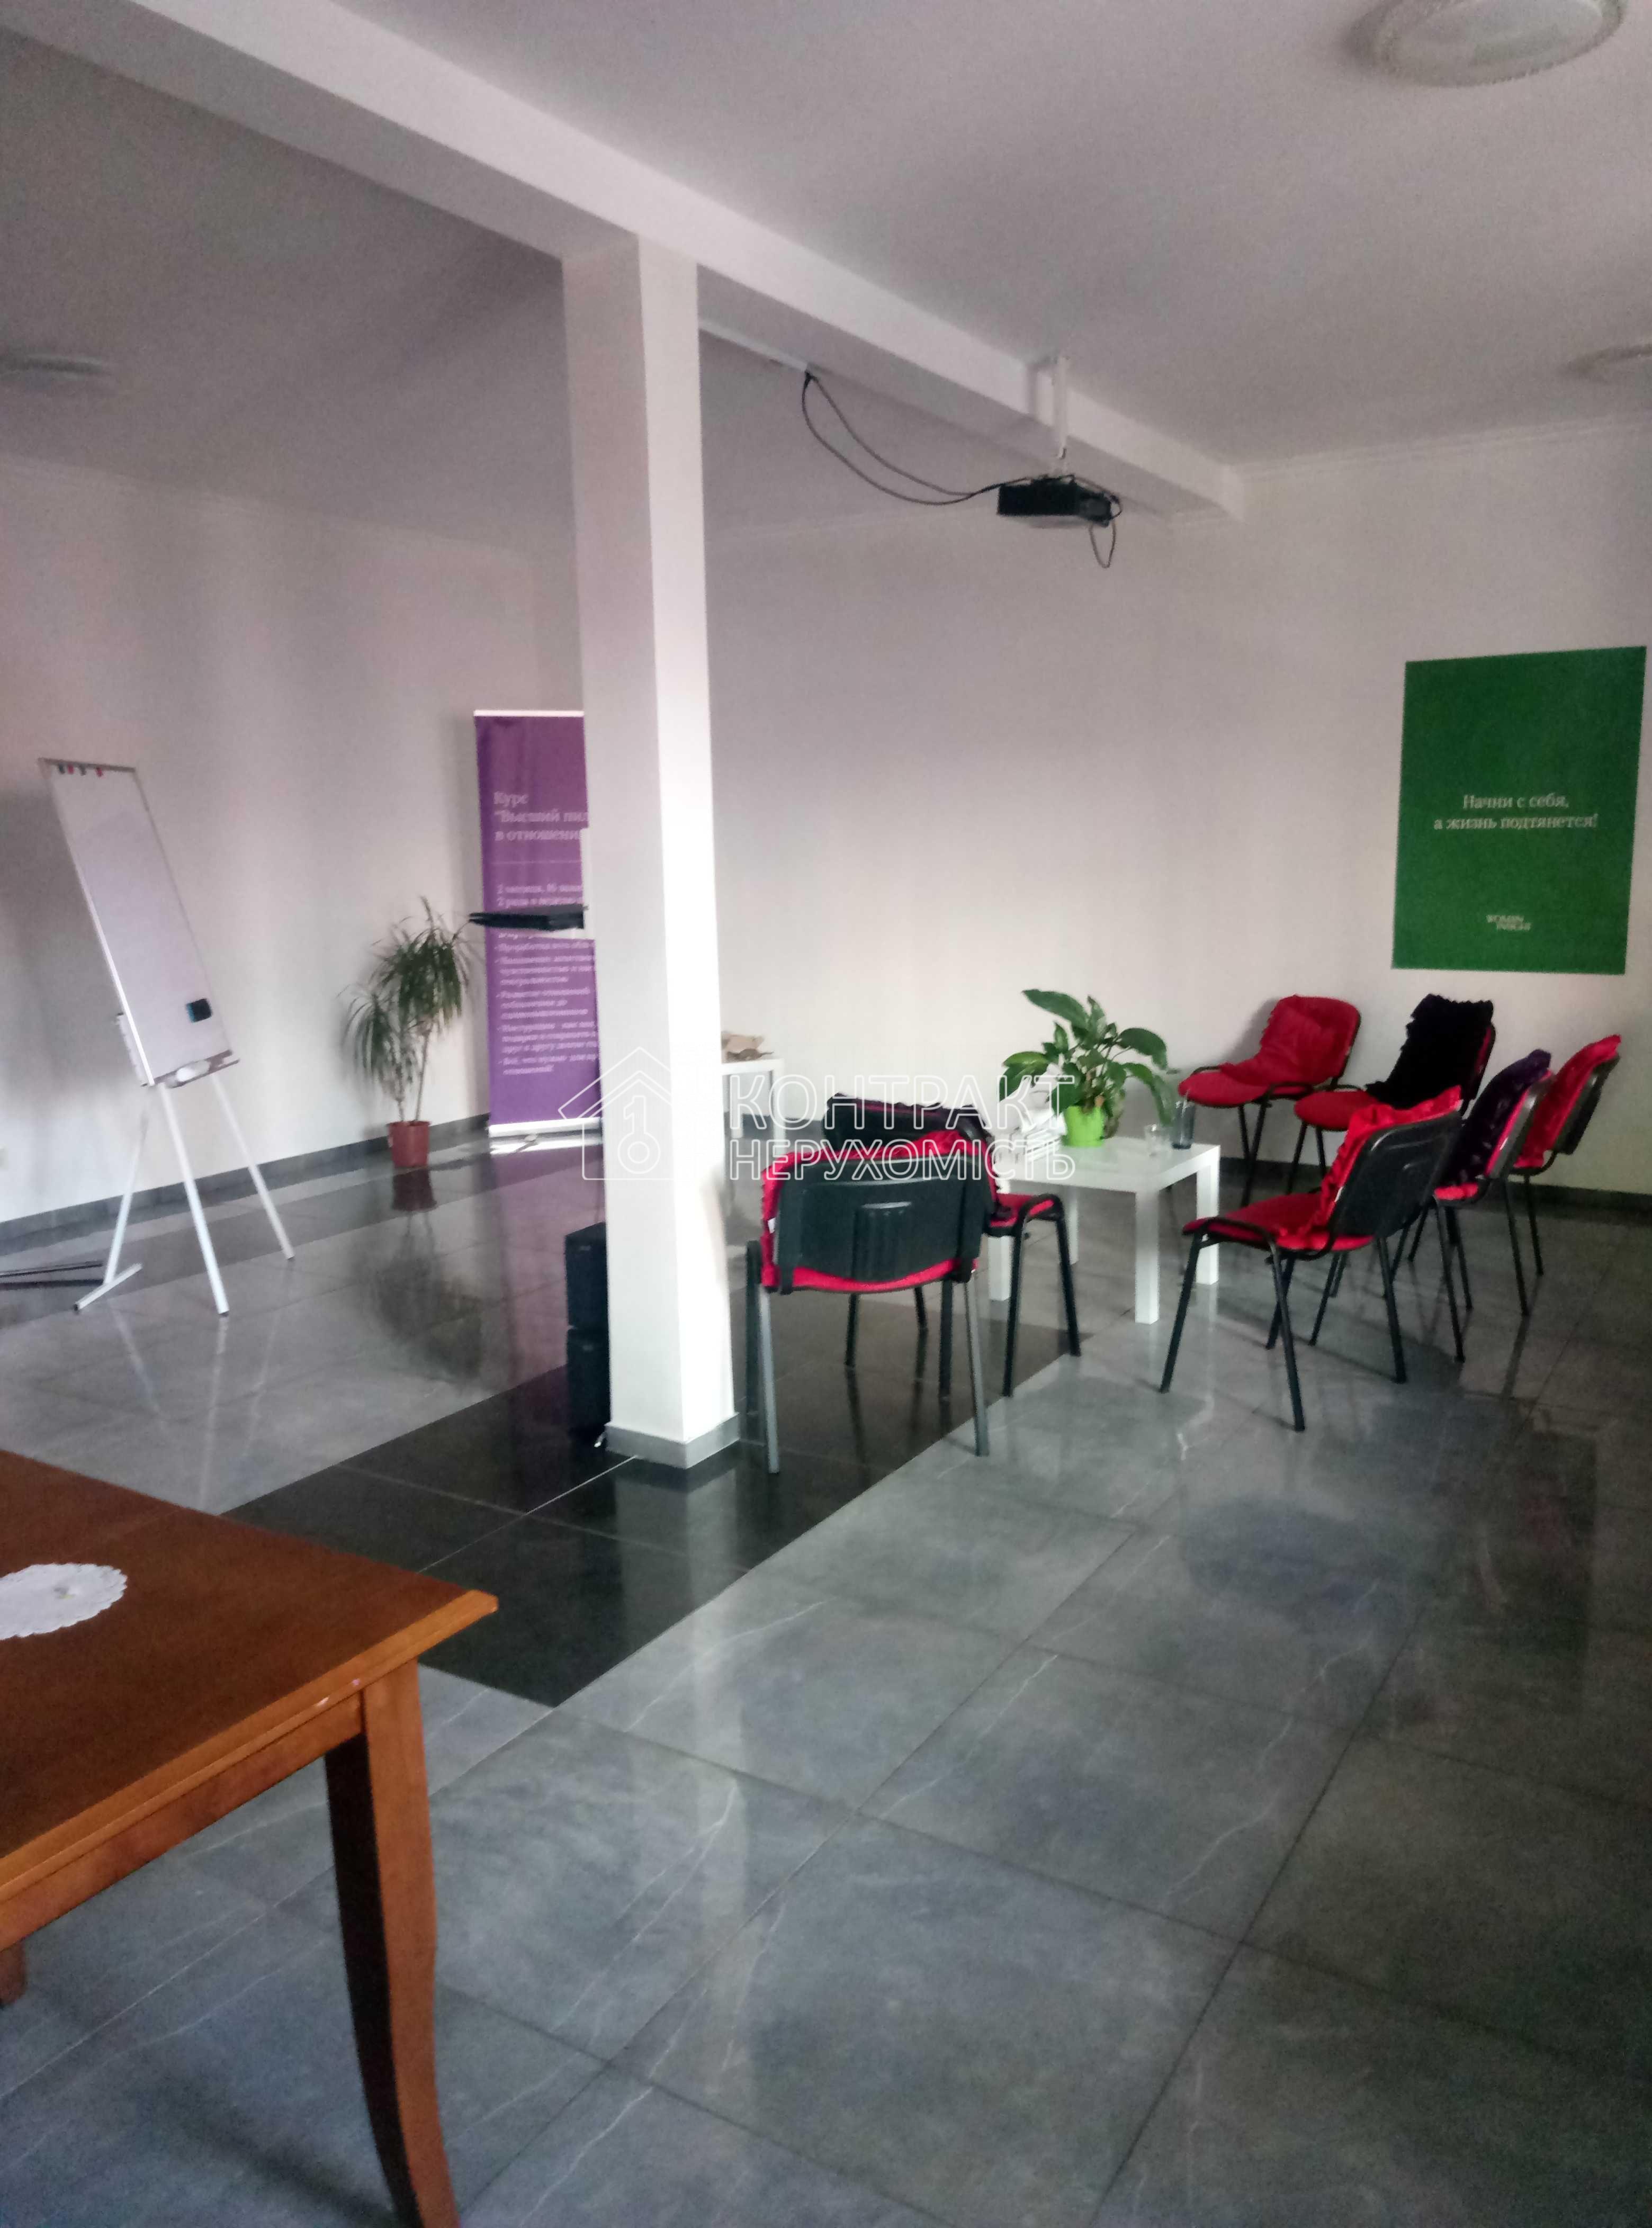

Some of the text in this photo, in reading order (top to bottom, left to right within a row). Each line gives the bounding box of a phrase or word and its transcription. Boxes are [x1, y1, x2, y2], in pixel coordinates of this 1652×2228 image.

[494, 791, 529, 807] Курс
[1463, 793, 1569, 809] Начни с себя,
[1434, 819, 1443, 830] а
[1446, 818, 1497, 830] жизнь
